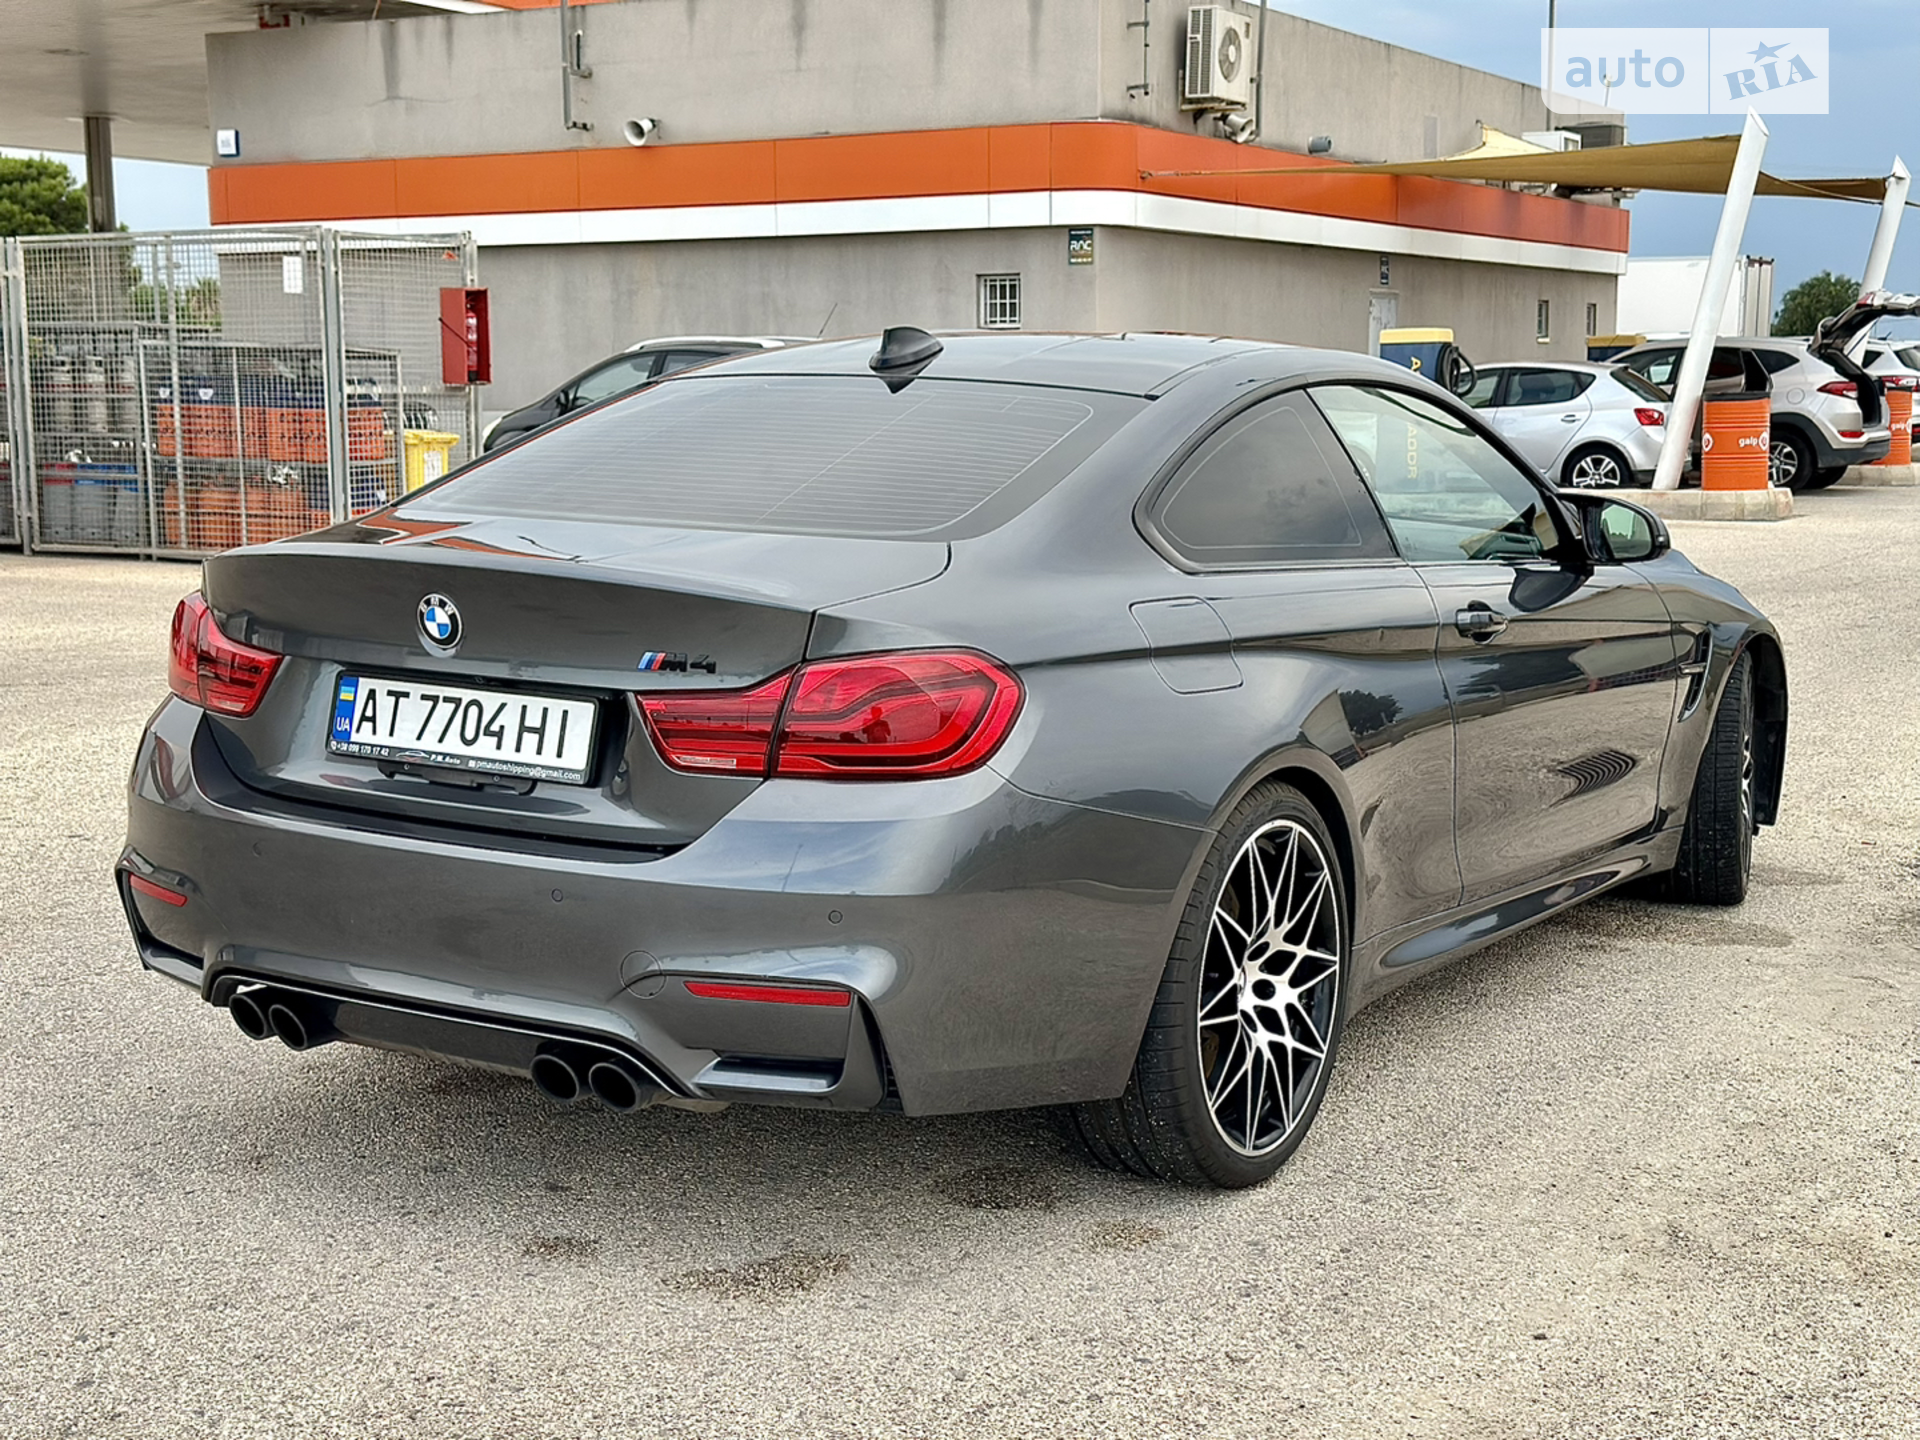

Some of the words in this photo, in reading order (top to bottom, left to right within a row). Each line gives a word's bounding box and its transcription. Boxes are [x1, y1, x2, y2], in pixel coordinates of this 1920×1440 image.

[1738, 436, 1758, 448] galp
[420, 596, 455, 616] BMW
[659, 651, 717, 674] M4
[336, 716, 350, 732] UA
[476, 760, 581, 780] pmautoshipping@gmail.com
